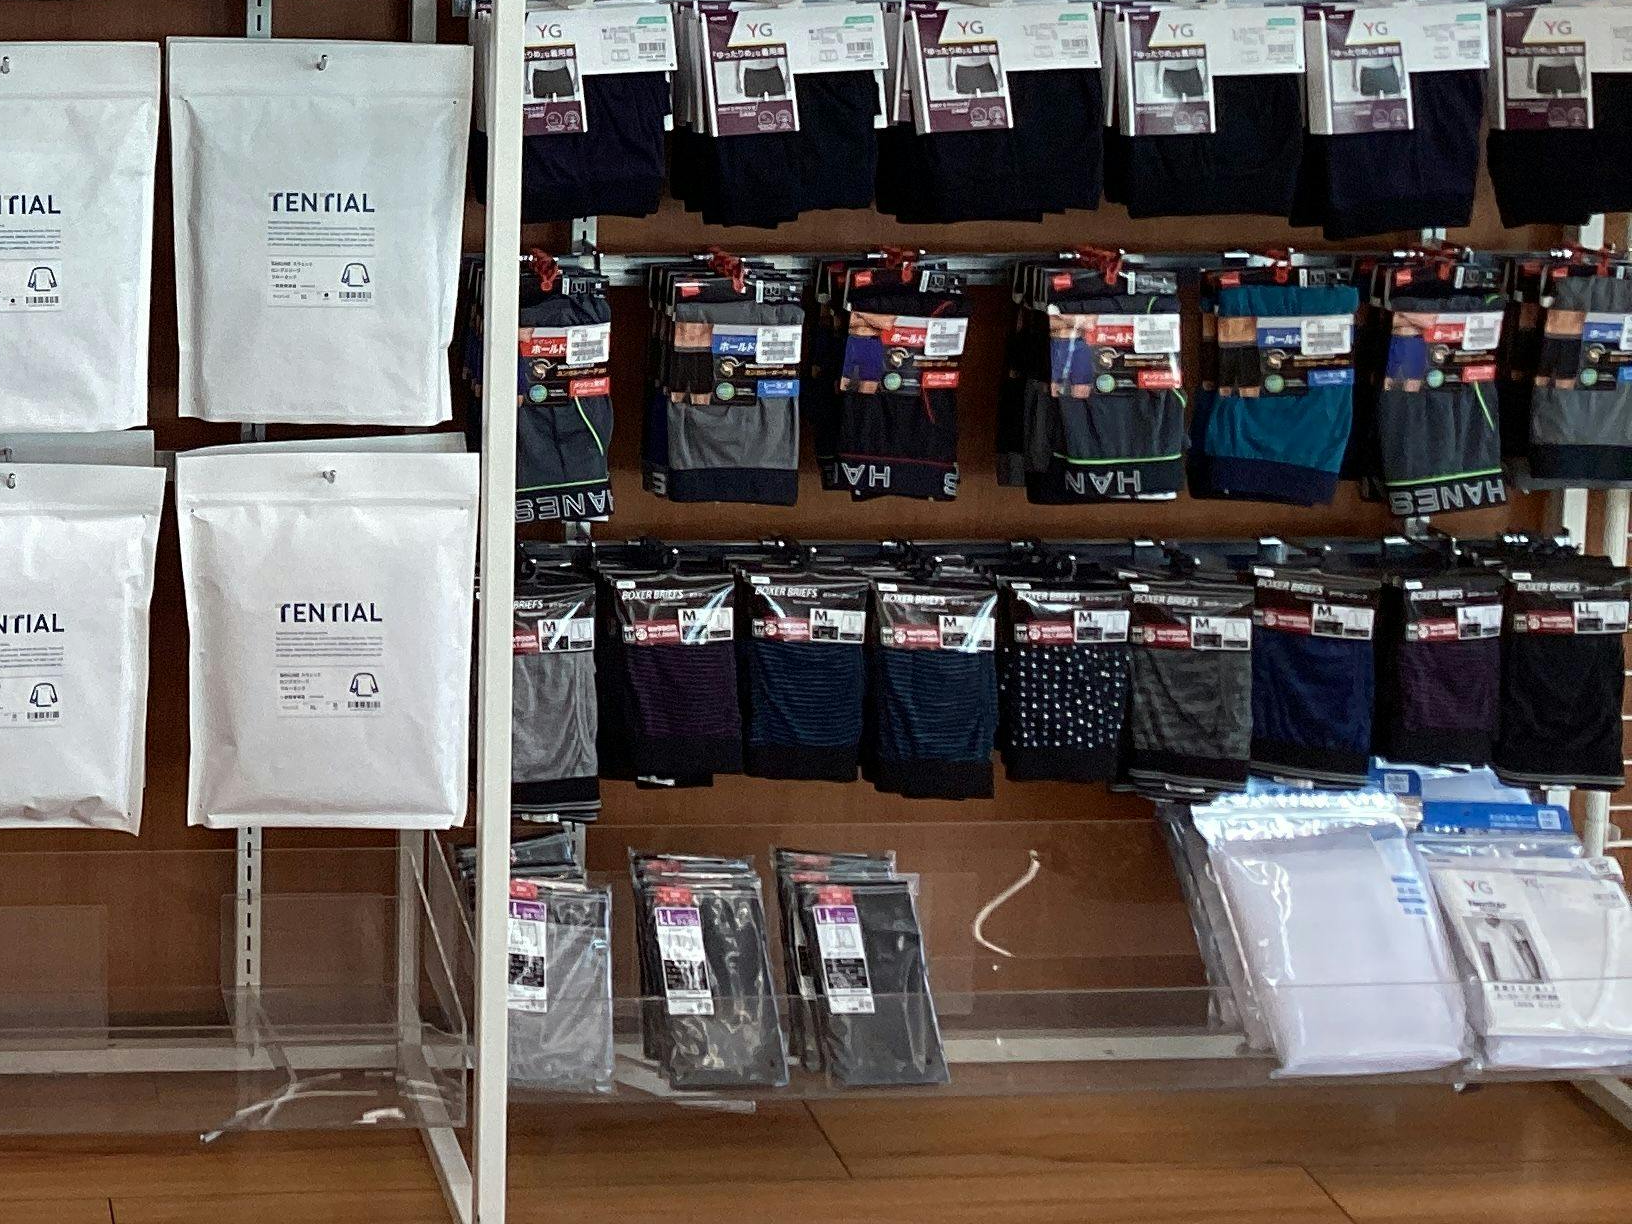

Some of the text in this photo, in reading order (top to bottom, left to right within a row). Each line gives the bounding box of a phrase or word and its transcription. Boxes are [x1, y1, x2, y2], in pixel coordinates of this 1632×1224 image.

[536, 23, 562, 38] YG
[747, 23, 773, 38] YG
[957, 21, 984, 36] YG
[1167, 23, 1194, 38] YG
[1362, 21, 1389, 37] YG
[1543, 19, 1573, 35] YG
[269, 192, 375, 213] TENTIAL
[1390, 478, 1508, 517] HANES
[516, 489, 614, 523] ANES
[275, 603, 383, 623] TENTIAL
[682, 609, 696, 620] M
[814, 610, 828, 622] M
[1079, 611, 1092, 622] M
[1317, 606, 1332, 616] M
[542, 620, 556, 632] M
[944, 616, 957, 627] M
[1195, 617, 1209, 628] M
